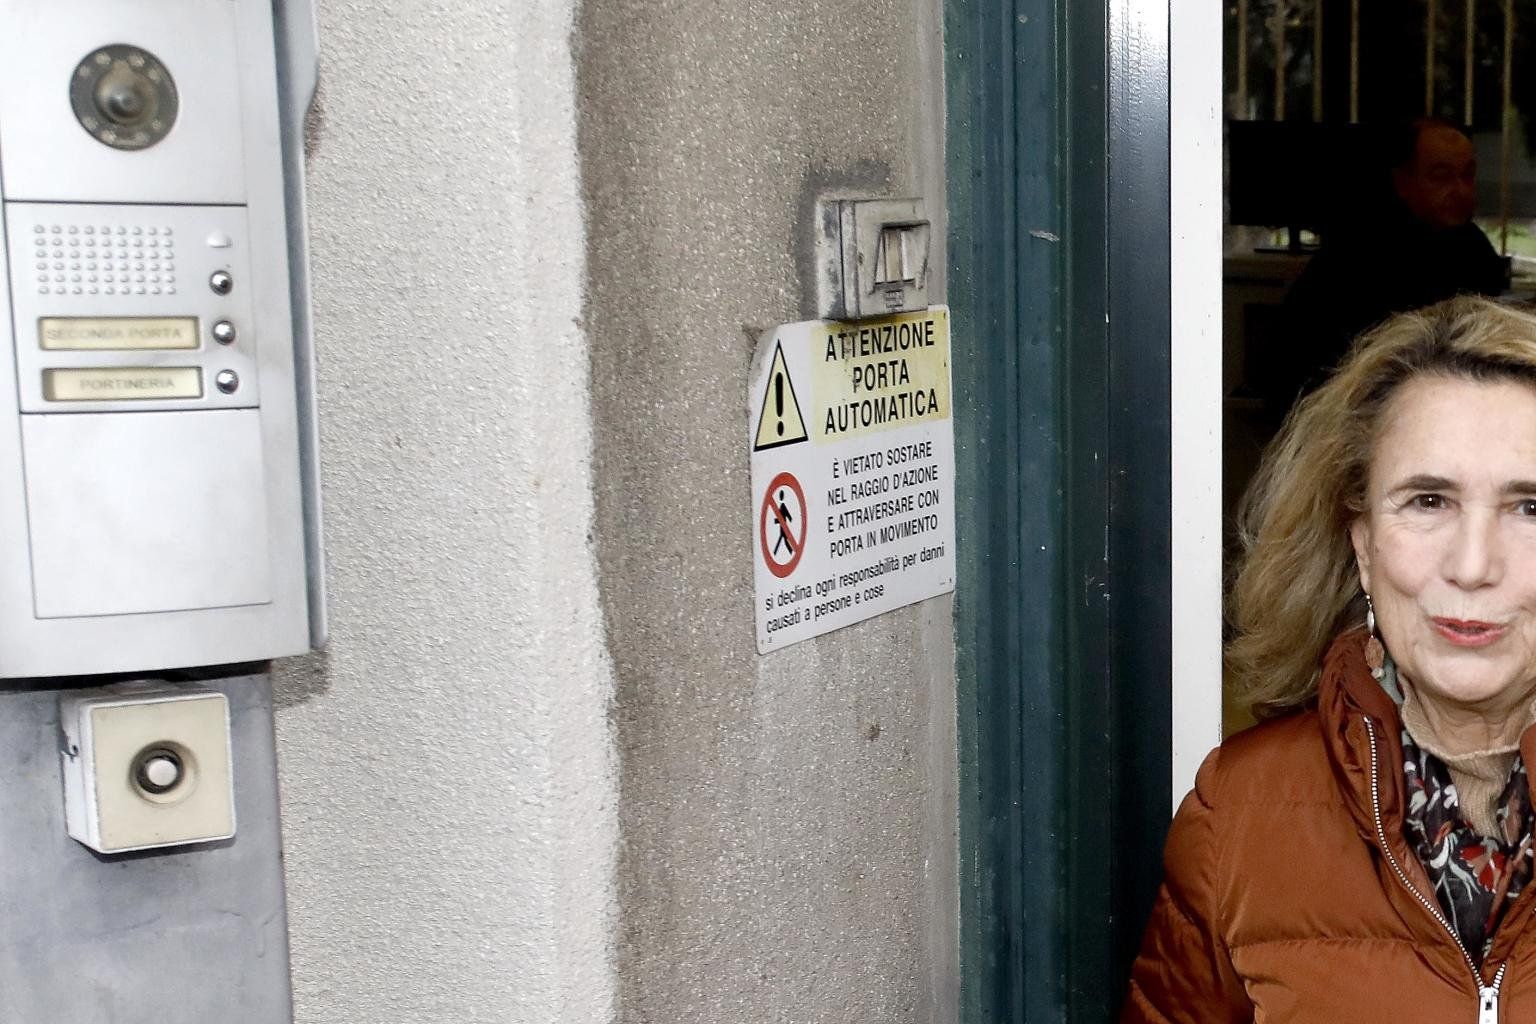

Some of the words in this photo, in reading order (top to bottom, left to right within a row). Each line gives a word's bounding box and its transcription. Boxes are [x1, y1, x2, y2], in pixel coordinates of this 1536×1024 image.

[46, 328, 124, 340] SECONDA
[128, 327, 181, 339] PORTA
[825, 320, 935, 362] ATTENZIONE
[79, 378, 176, 390] PORTINERIA
[852, 359, 910, 393] PORTA
[825, 388, 939, 434] AUTOMATICA
[832, 458, 840, 479] È
[843, 452, 883, 476] VIETATO
[887, 441, 932, 466] SOSTARE
[827, 487, 847, 507] NEL
[851, 476, 889, 501] RAGGIO
[893, 464, 938, 490] D'AZIONE
[827, 516, 834, 533] E
[838, 495, 914, 530] ATTRAVERSARE
[917, 489, 939, 508] CON
[830, 535, 864, 558] PORTA
[867, 530, 877, 548] IN
[880, 514, 938, 544] MOVIMENTO
[765, 593, 774, 611] si
[778, 585, 812, 607] declina
[815, 574, 836, 597] ogni
[839, 554, 899, 588] responsabilità
[902, 552, 916, 572] per
[920, 541, 945, 562] danni
[766, 607, 801, 633] causati
[804, 608, 811, 621] a
[814, 594, 851, 621] persone
[854, 592, 860, 604] e
[863, 583, 884, 602] cose
